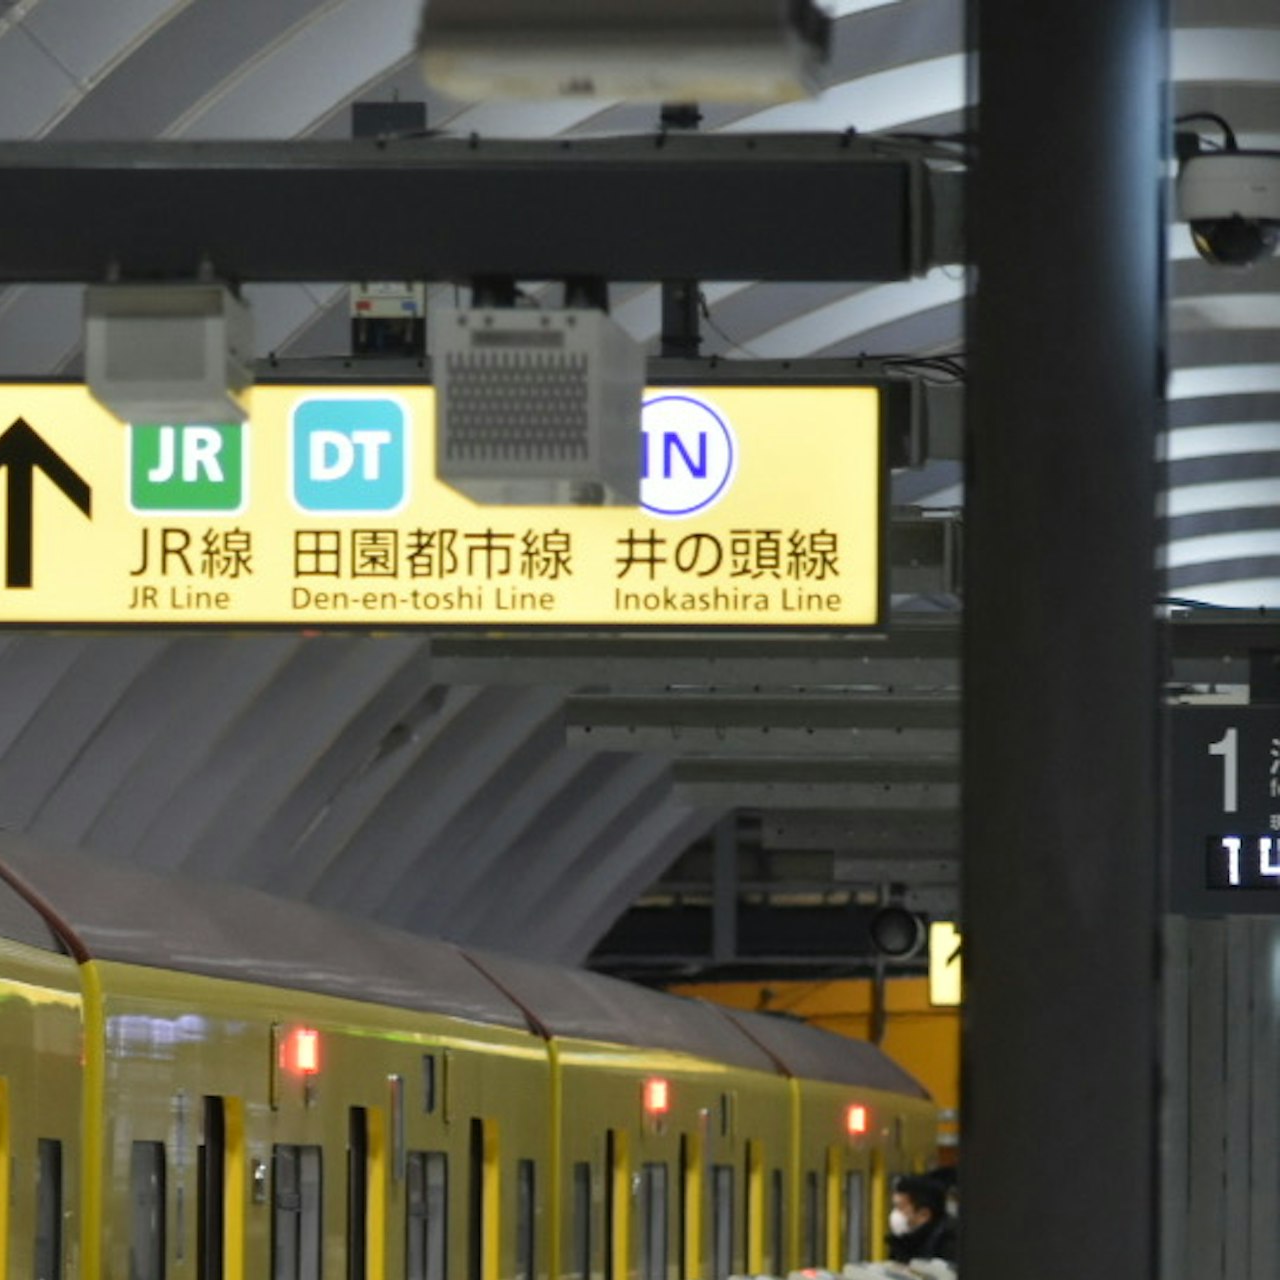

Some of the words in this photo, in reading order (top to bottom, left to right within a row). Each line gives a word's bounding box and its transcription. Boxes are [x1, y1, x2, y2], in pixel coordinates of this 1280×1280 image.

[148, 426, 224, 483] JR
[309, 430, 391, 481] DT
[641, 431, 708, 479] IN
[130, 526, 254, 579] JR線
[293, 527, 574, 580] 田園都市線
[615, 527, 841, 581] 井の頭線
[128, 586, 159, 610] JR
[171, 585, 231, 610] Line
[292, 585, 483, 611] Den-en-toshi
[496, 585, 555, 611] Line
[615, 587, 769, 612] Inokashira
[782, 587, 842, 612] Line
[1208, 727, 1237, 812] 1
